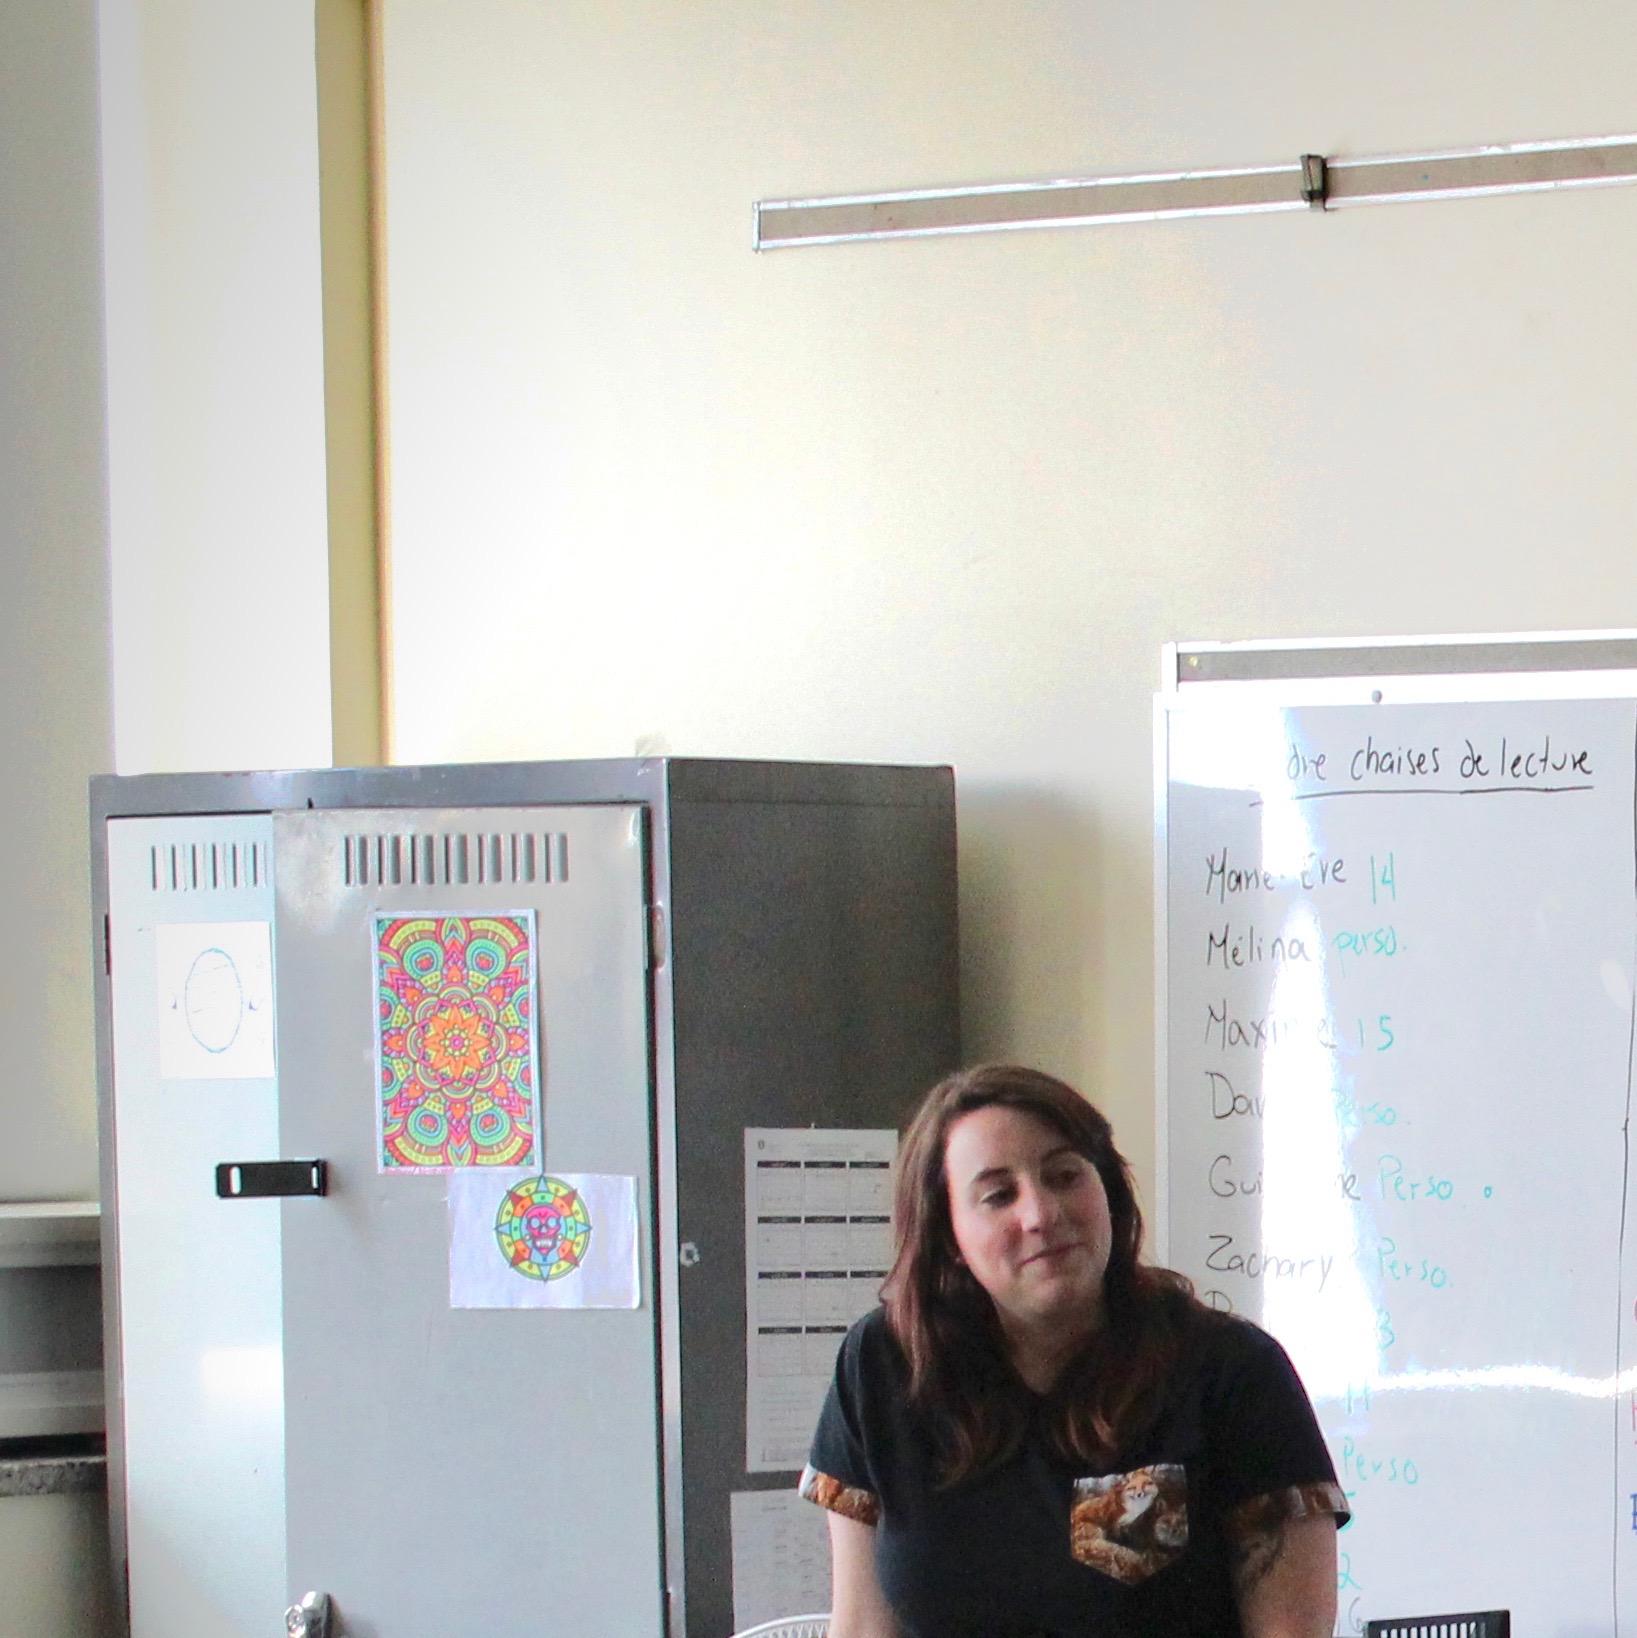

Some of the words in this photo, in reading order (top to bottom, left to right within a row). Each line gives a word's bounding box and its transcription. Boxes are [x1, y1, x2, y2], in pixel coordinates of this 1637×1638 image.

[1350, 736, 1442, 781] chaises
[1459, 740, 1490, 779] de
[1501, 736, 1594, 779] lecture
[1371, 851, 1396, 904] 14
[1206, 925, 1311, 968] Mélina
[1205, 1235, 1335, 1293] Zachary
